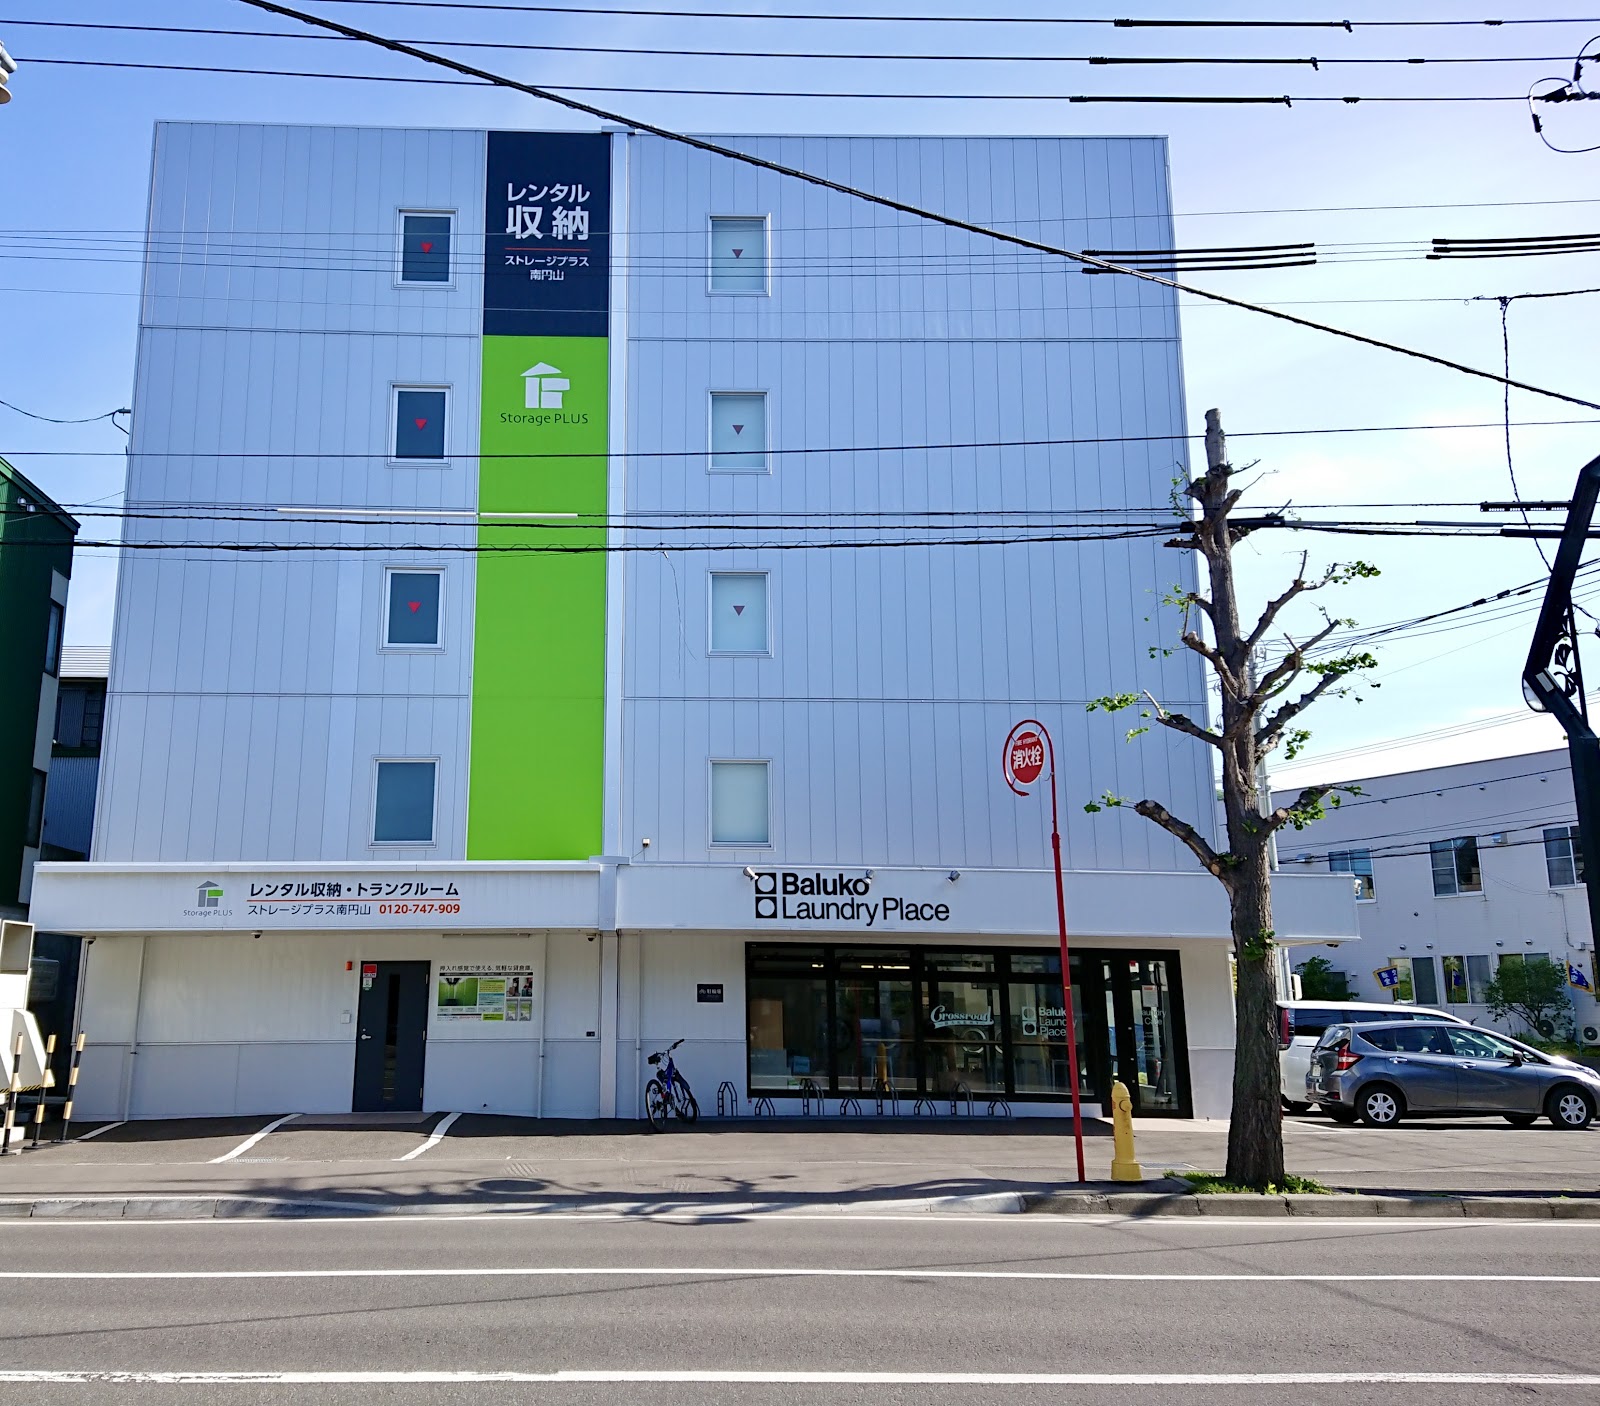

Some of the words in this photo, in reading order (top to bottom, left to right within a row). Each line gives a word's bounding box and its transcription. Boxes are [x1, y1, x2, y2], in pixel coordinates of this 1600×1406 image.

[507, 182, 591, 204] レンタル
[505, 204, 589, 241] 収納
[505, 255, 589, 267] ストレージプラス
[529, 269, 565, 282] 南円山
[500, 412, 551, 427] Storage
[554, 413, 589, 425] PLUS
[1013, 745, 1042, 769] 消火栓
[250, 882, 460, 898] レンタル収納・トランクルーム
[782, 872, 870, 896] Baluko
[183, 908, 211, 918] Storage
[213, 909, 233, 917] PLUS
[247, 904, 372, 916] ストレージプラス南円山
[379, 903, 461, 914] 0120-747-909
[782, 897, 879, 927] Laundry
[883, 897, 950, 922] Place
[930, 1005, 992, 1023] Crossroad
[1038, 1006, 1073, 1017] Baluk
[1039, 1017, 1078, 1029] Launy
[1039, 1026, 1067, 1037] Place
